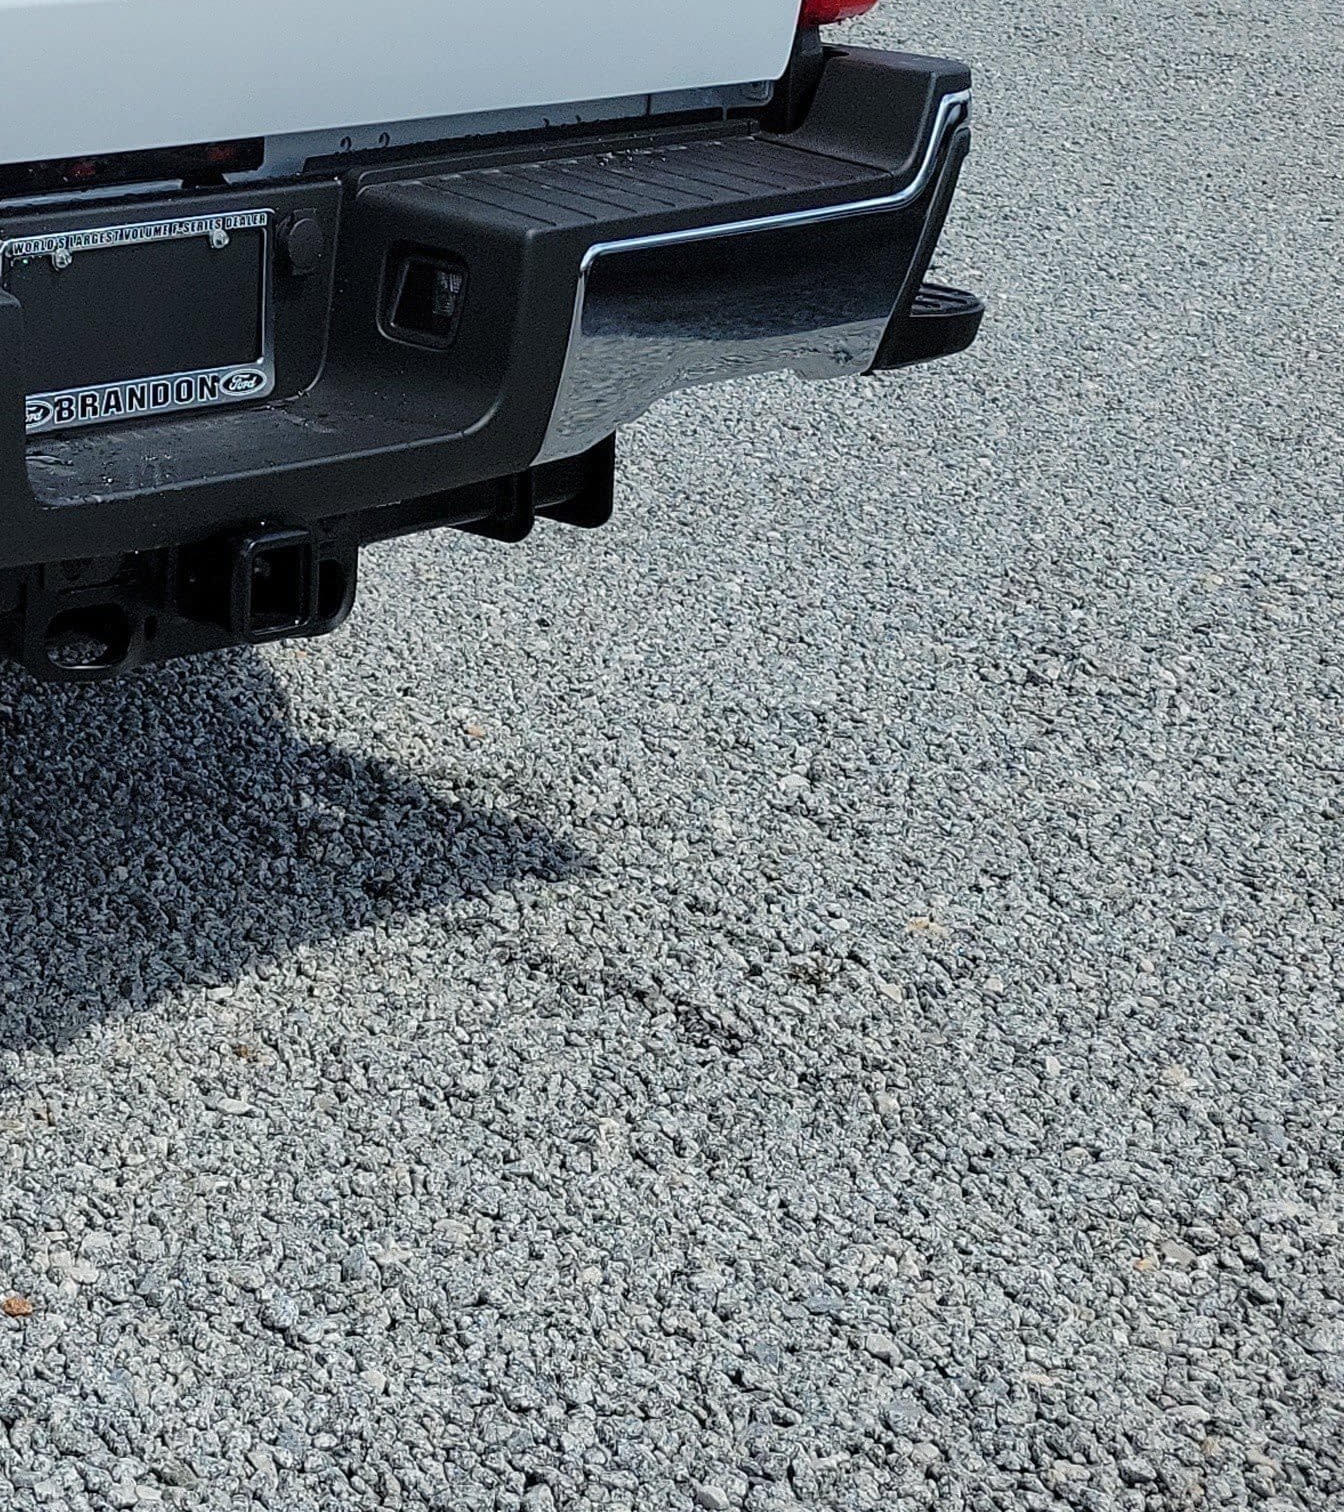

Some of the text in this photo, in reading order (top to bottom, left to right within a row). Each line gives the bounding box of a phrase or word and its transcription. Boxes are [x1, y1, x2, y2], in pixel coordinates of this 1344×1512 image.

[69, 229, 120, 248] LARGEST
[123, 223, 170, 241] VOLUME
[171, 217, 222, 235] F-SERIES
[225, 212, 268, 230] DEALER
[54, 373, 221, 424] BRANDON
[228, 373, 258, 391] Ford
